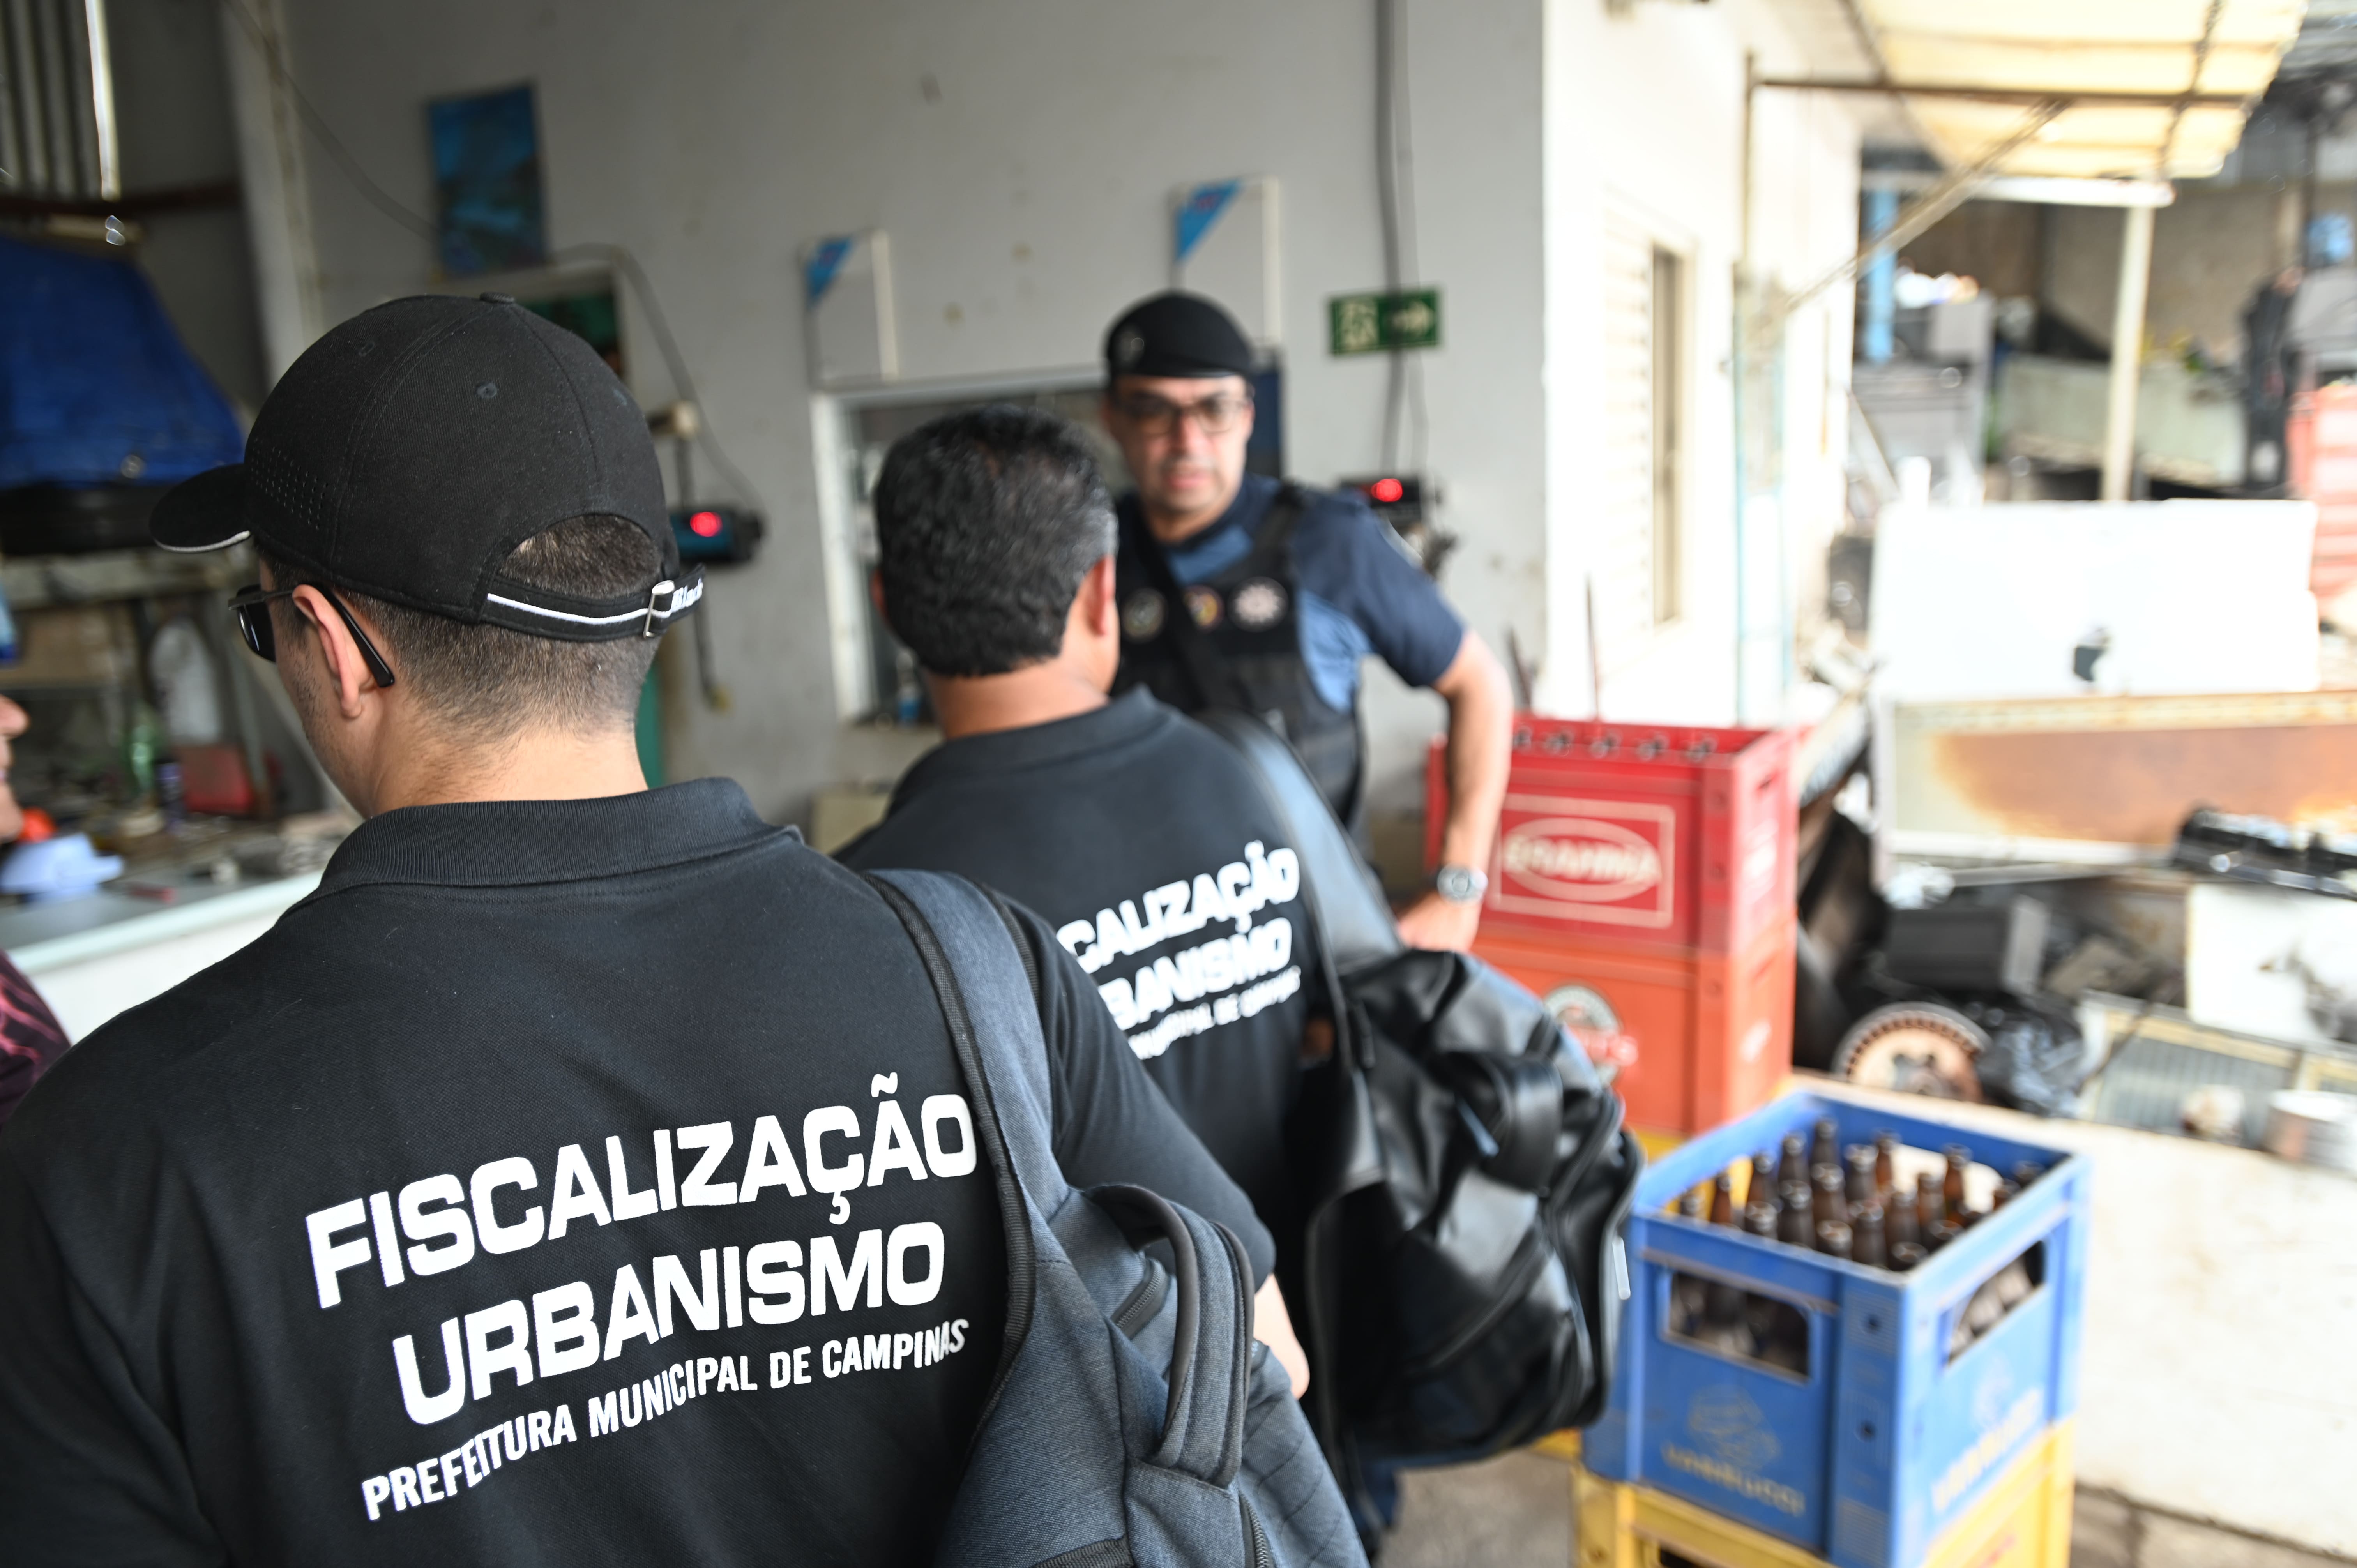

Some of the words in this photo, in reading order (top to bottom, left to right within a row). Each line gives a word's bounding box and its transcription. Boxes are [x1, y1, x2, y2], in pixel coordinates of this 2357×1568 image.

[1056, 840, 1300, 974] CALIZAÇÃO
[1098, 918, 1292, 1031] BANISMO
[306, 1072, 977, 1309] FISCALIZAÇÃO
[362, 1404, 578, 1521] PREFEITURA
[588, 1355, 758, 1438] MUNICIPAL
[769, 1346, 812, 1390] DE
[822, 1319, 969, 1379] CAMPINAS
[392, 1221, 945, 1425] URBANISMO
